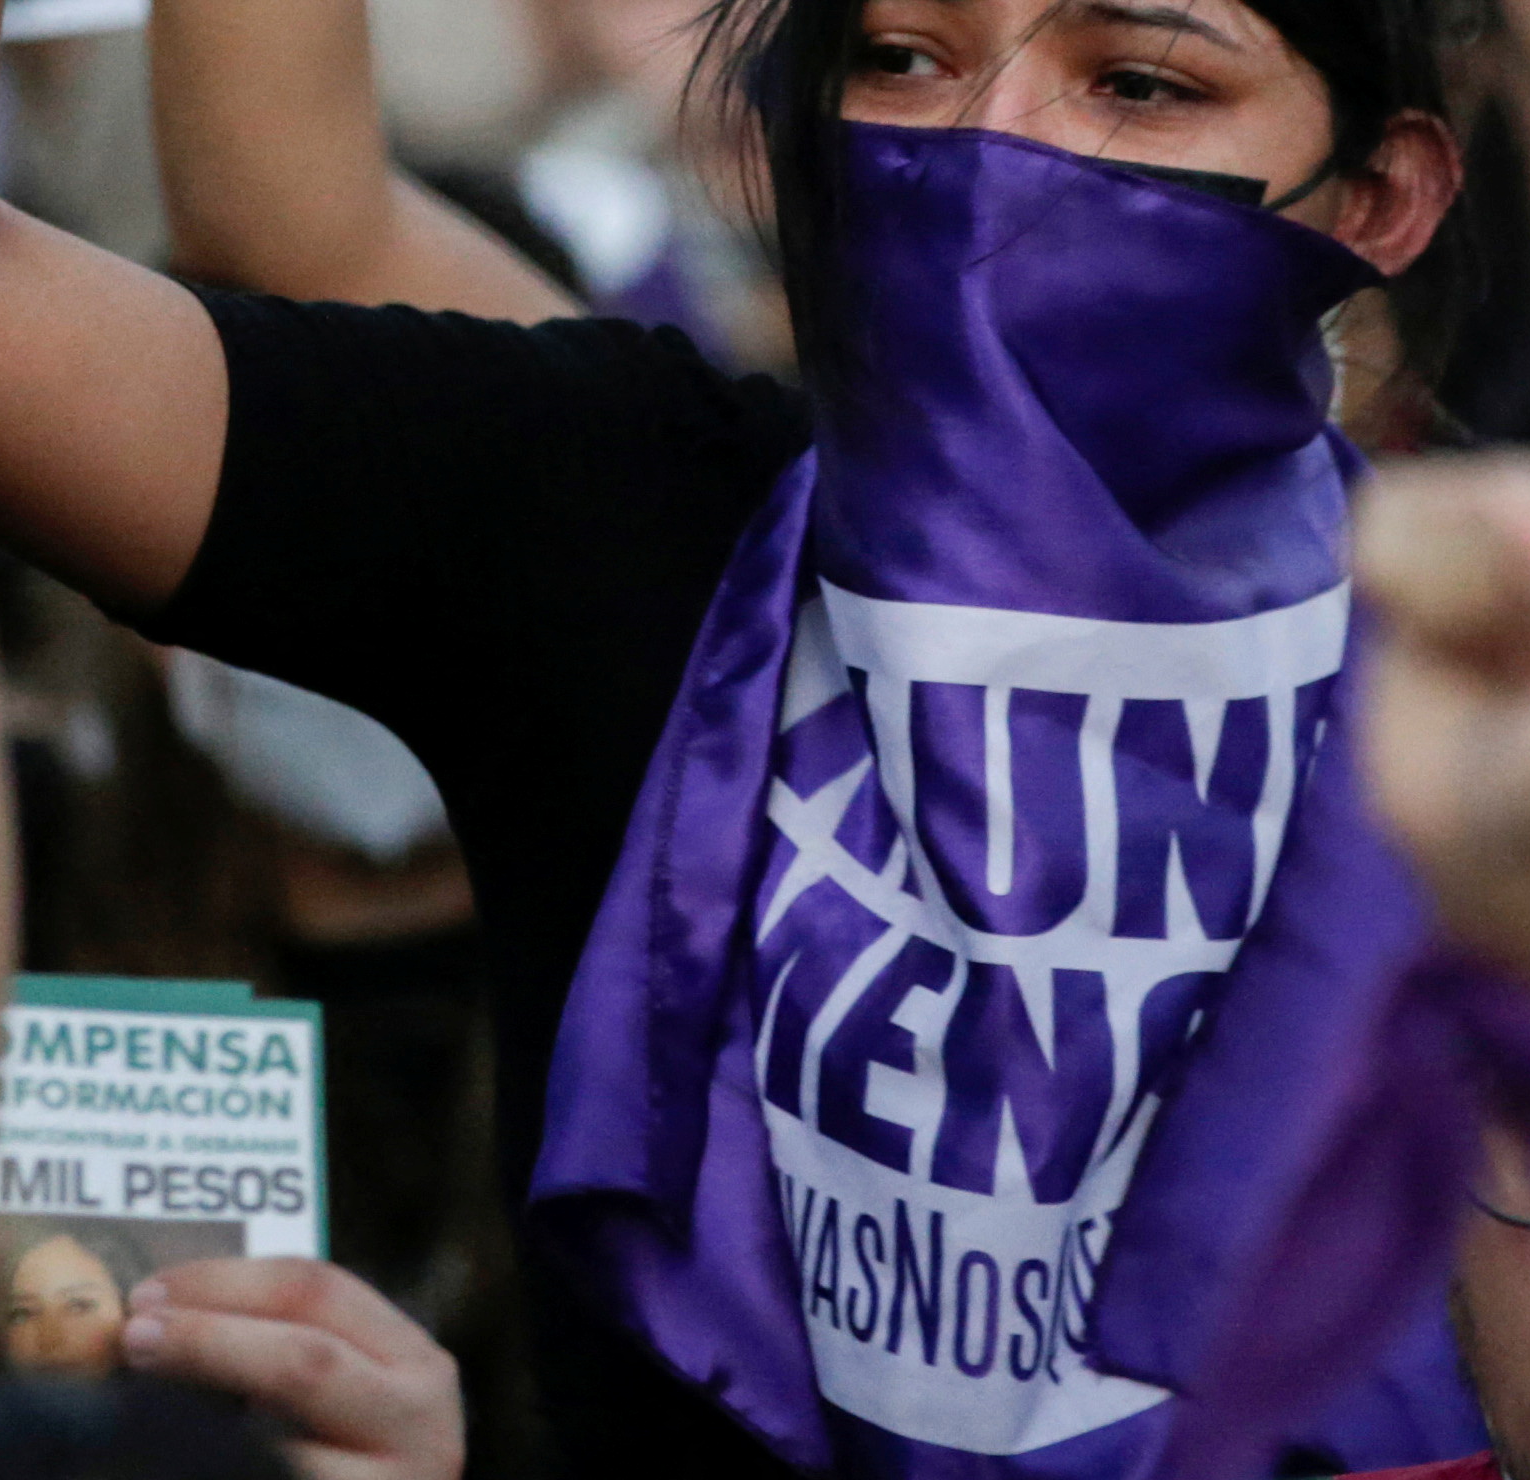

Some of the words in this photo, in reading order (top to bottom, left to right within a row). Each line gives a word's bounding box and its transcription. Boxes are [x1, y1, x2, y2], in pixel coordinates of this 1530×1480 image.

[3, 1020, 301, 1078] MPENSA
[0, 1155, 102, 1207] MIL
[123, 1161, 305, 1216] PESOS
